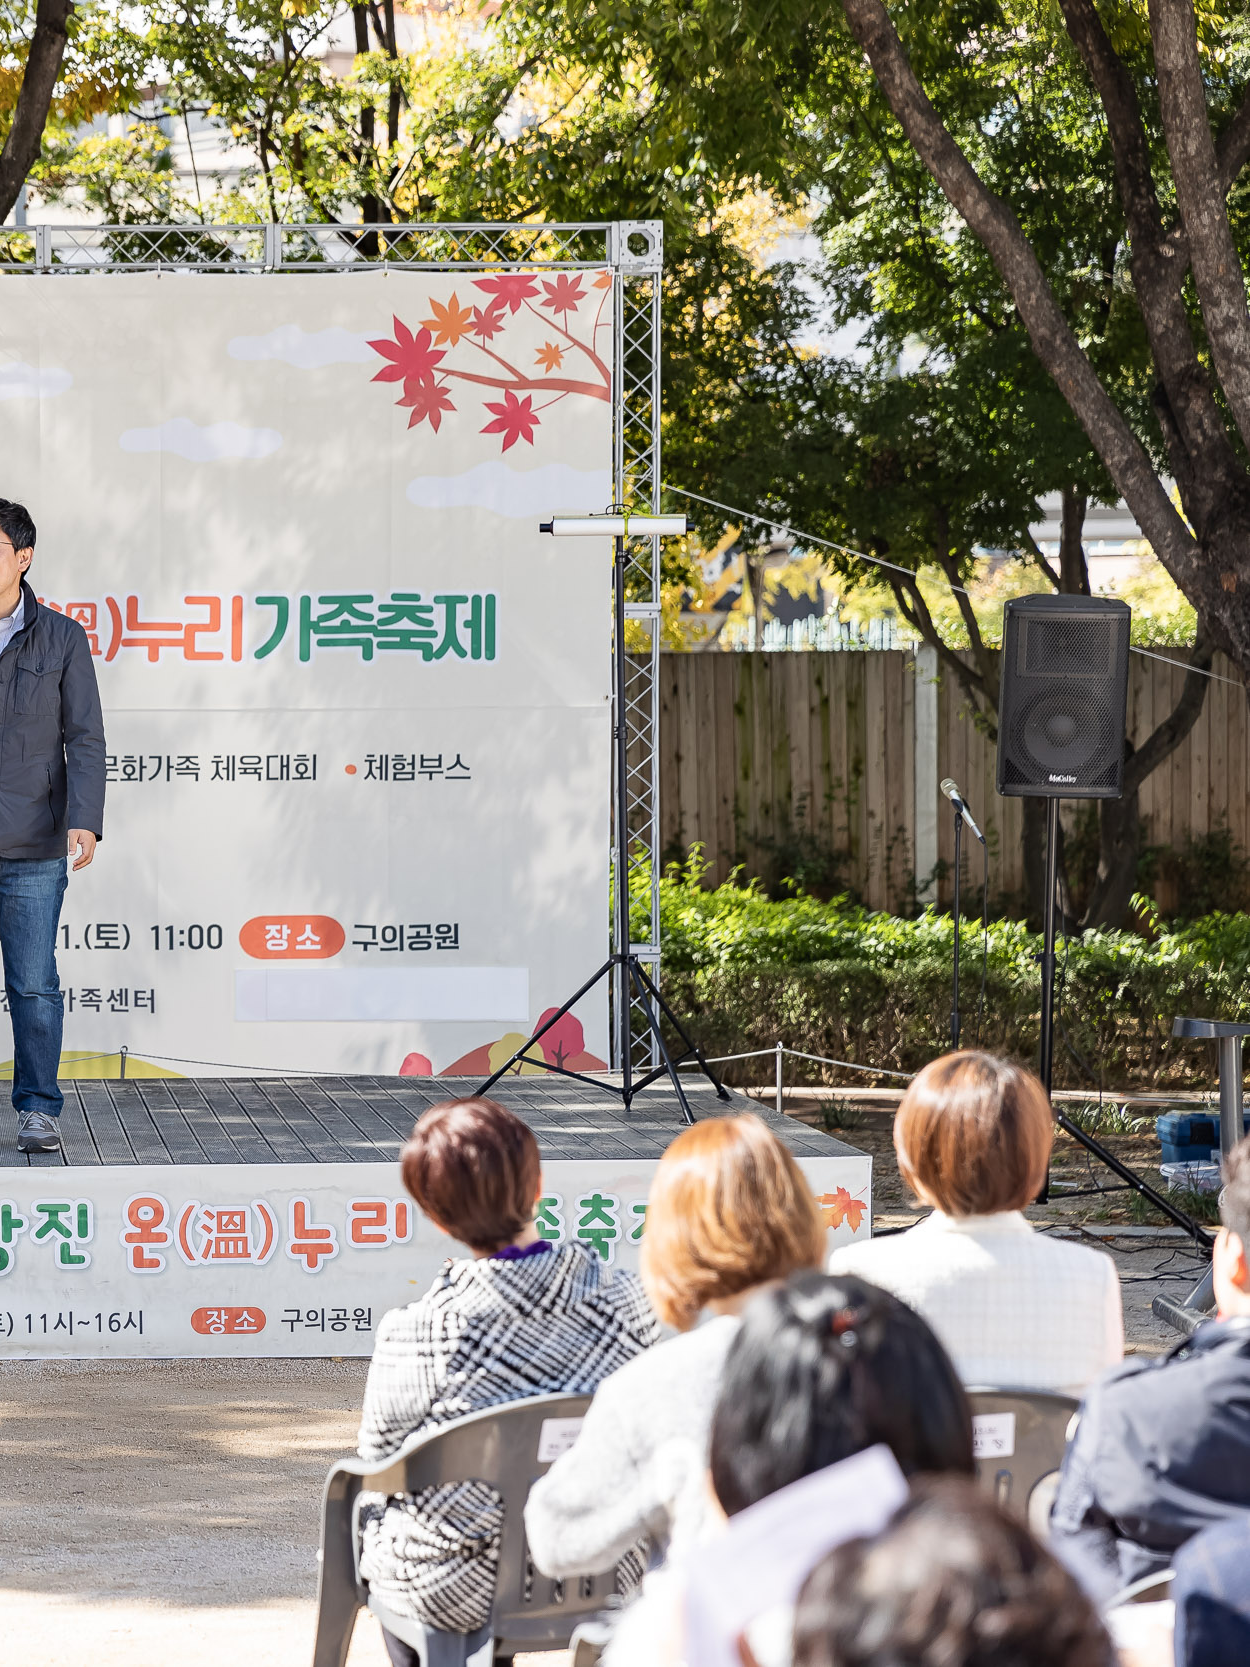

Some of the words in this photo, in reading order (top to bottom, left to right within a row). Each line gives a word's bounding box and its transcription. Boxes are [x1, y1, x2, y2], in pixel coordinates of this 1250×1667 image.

[253, 593, 497, 664] 가족축제
[210, 753, 318, 783] 체육대회
[364, 752, 472, 782] 체험부스
[150, 923, 224, 951] 11:00
[264, 923, 322, 952] 장소
[351, 922, 461, 953] 구의공원
[124, 1196, 409, 1270] 온(溫)누리
[205, 1309, 258, 1335] 장소
[280, 1306, 373, 1333] 구의공원
